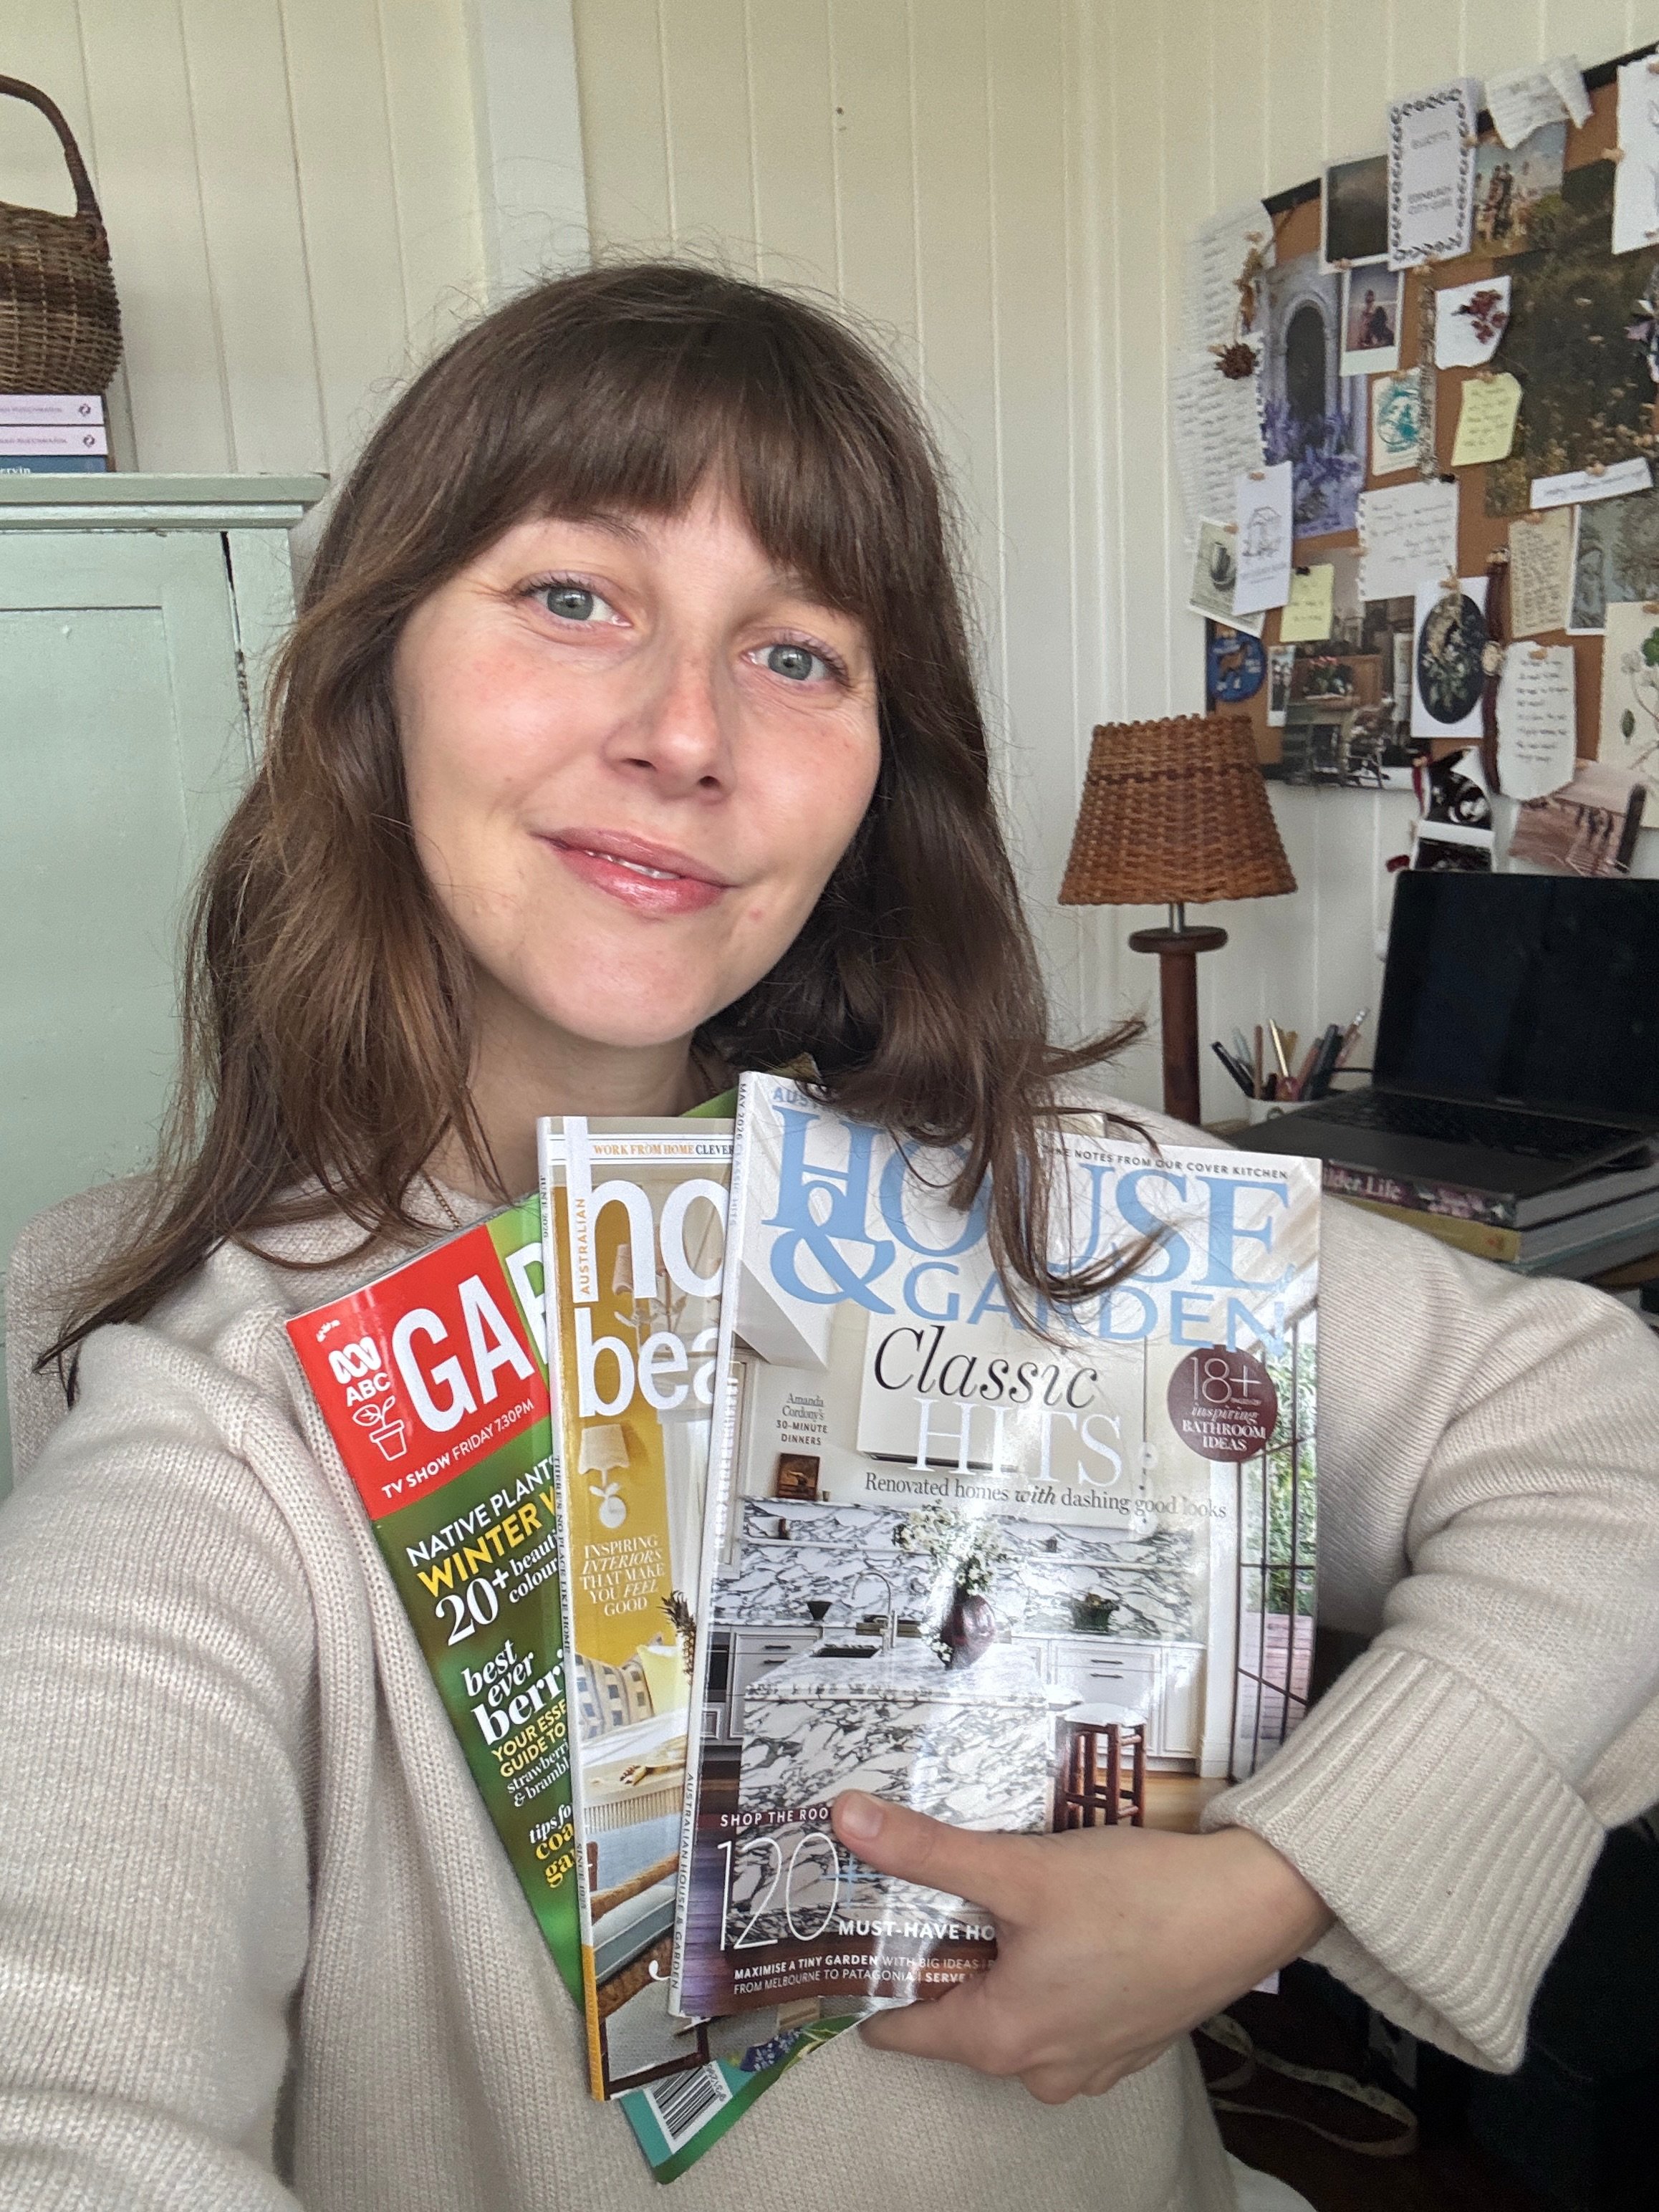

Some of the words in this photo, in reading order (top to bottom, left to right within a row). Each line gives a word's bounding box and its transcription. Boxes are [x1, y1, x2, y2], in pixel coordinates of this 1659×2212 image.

[736, 1112, 745, 1140] 2026
[593, 1144, 628, 1155] WORK
[630, 1144, 662, 1155] FROM
[664, 1144, 695, 1155] HOME
[1074, 1149, 1114, 1163] NOTES
[1117, 1155, 1152, 1167] FROM
[1155, 1158, 1183, 1170] OUR
[1186, 1161, 1228, 1175] COVER
[1232, 1165, 1288, 1179] KITCHEN
[575, 1198, 591, 1295] AUSTRALIAN
[770, 1180, 896, 1315] &
[874, 1324, 1099, 1410] Classic
[1190, 1356, 1262, 1405] 18+
[345, 1372, 392, 1407] ABC
[775, 1419, 828, 1434] 30-MINUTE
[1181, 1418, 1266, 1440] BATHROOM
[1190, 1403, 1260, 1425] inspiring
[781, 1433, 822, 1446] DINNERS
[907, 1397, 1125, 1489] HITS
[1202, 1435, 1247, 1452] IDEAS
[381, 1478, 403, 1499] TV
[405, 1452, 451, 1488] SHOW
[452, 1423, 494, 1461] FRIDAY
[864, 1472, 950, 1496] Renovated
[954, 1479, 1009, 1502] homes
[1014, 1485, 1057, 1505] with
[1061, 1489, 1131, 1515] dashing
[1134, 1495, 1179, 1518] good
[1183, 1498, 1226, 1519] looks
[405, 1503, 492, 1567] NATIVE
[557, 1514, 564, 1533] NO
[417, 1503, 544, 1598] WINTER
[582, 1547, 663, 1575] INTERIORS
[584, 1534, 659, 1559] INSPIRING
[579, 1570, 622, 1590] THAT
[625, 1562, 665, 1581] MAKE
[589, 1587, 619, 1604] YOU
[623, 1578, 658, 1598] FEEL
[435, 1568, 510, 1647] 20+
[560, 1580, 569, 1612] LIKE
[604, 1597, 648, 1617] GOOD
[562, 1616, 572, 1653] HOME
[461, 1639, 517, 1697] best
[488, 1652, 534, 1707] ever
[491, 1724, 537, 1762] YOUR
[500, 1736, 549, 1778] GUIDE
[547, 1722, 566, 1744] TO
[514, 1792, 526, 1808] &
[681, 1772, 694, 1860] AUSTRALIAN
[529, 1815, 558, 1845] tips
[720, 1811, 763, 1827] SHOP
[768, 1809, 794, 1823] THE
[576, 1842, 586, 1882] SINCE
[677, 1864, 688, 1912] HOUSE
[838, 1920, 960, 1941] MUST-HAVE
[670, 1931, 683, 1990] GARDEN
[734, 1961, 787, 1981] MAXIMISE
[788, 1960, 796, 1971] A
[798, 1956, 822, 1968] TINY
[824, 1954, 878, 1966] GARDEN
[881, 1956, 915, 1967] WITH
[919, 1958, 940, 1969] BIG
[943, 1958, 979, 1970] IDEAS
[734, 1981, 763, 1995] FROM
[764, 1970, 821, 1990] MELBOURNE
[824, 1968, 839, 1980] TO
[842, 1968, 915, 1982] PATAGONIA
[925, 1972, 966, 1984] SERVE
